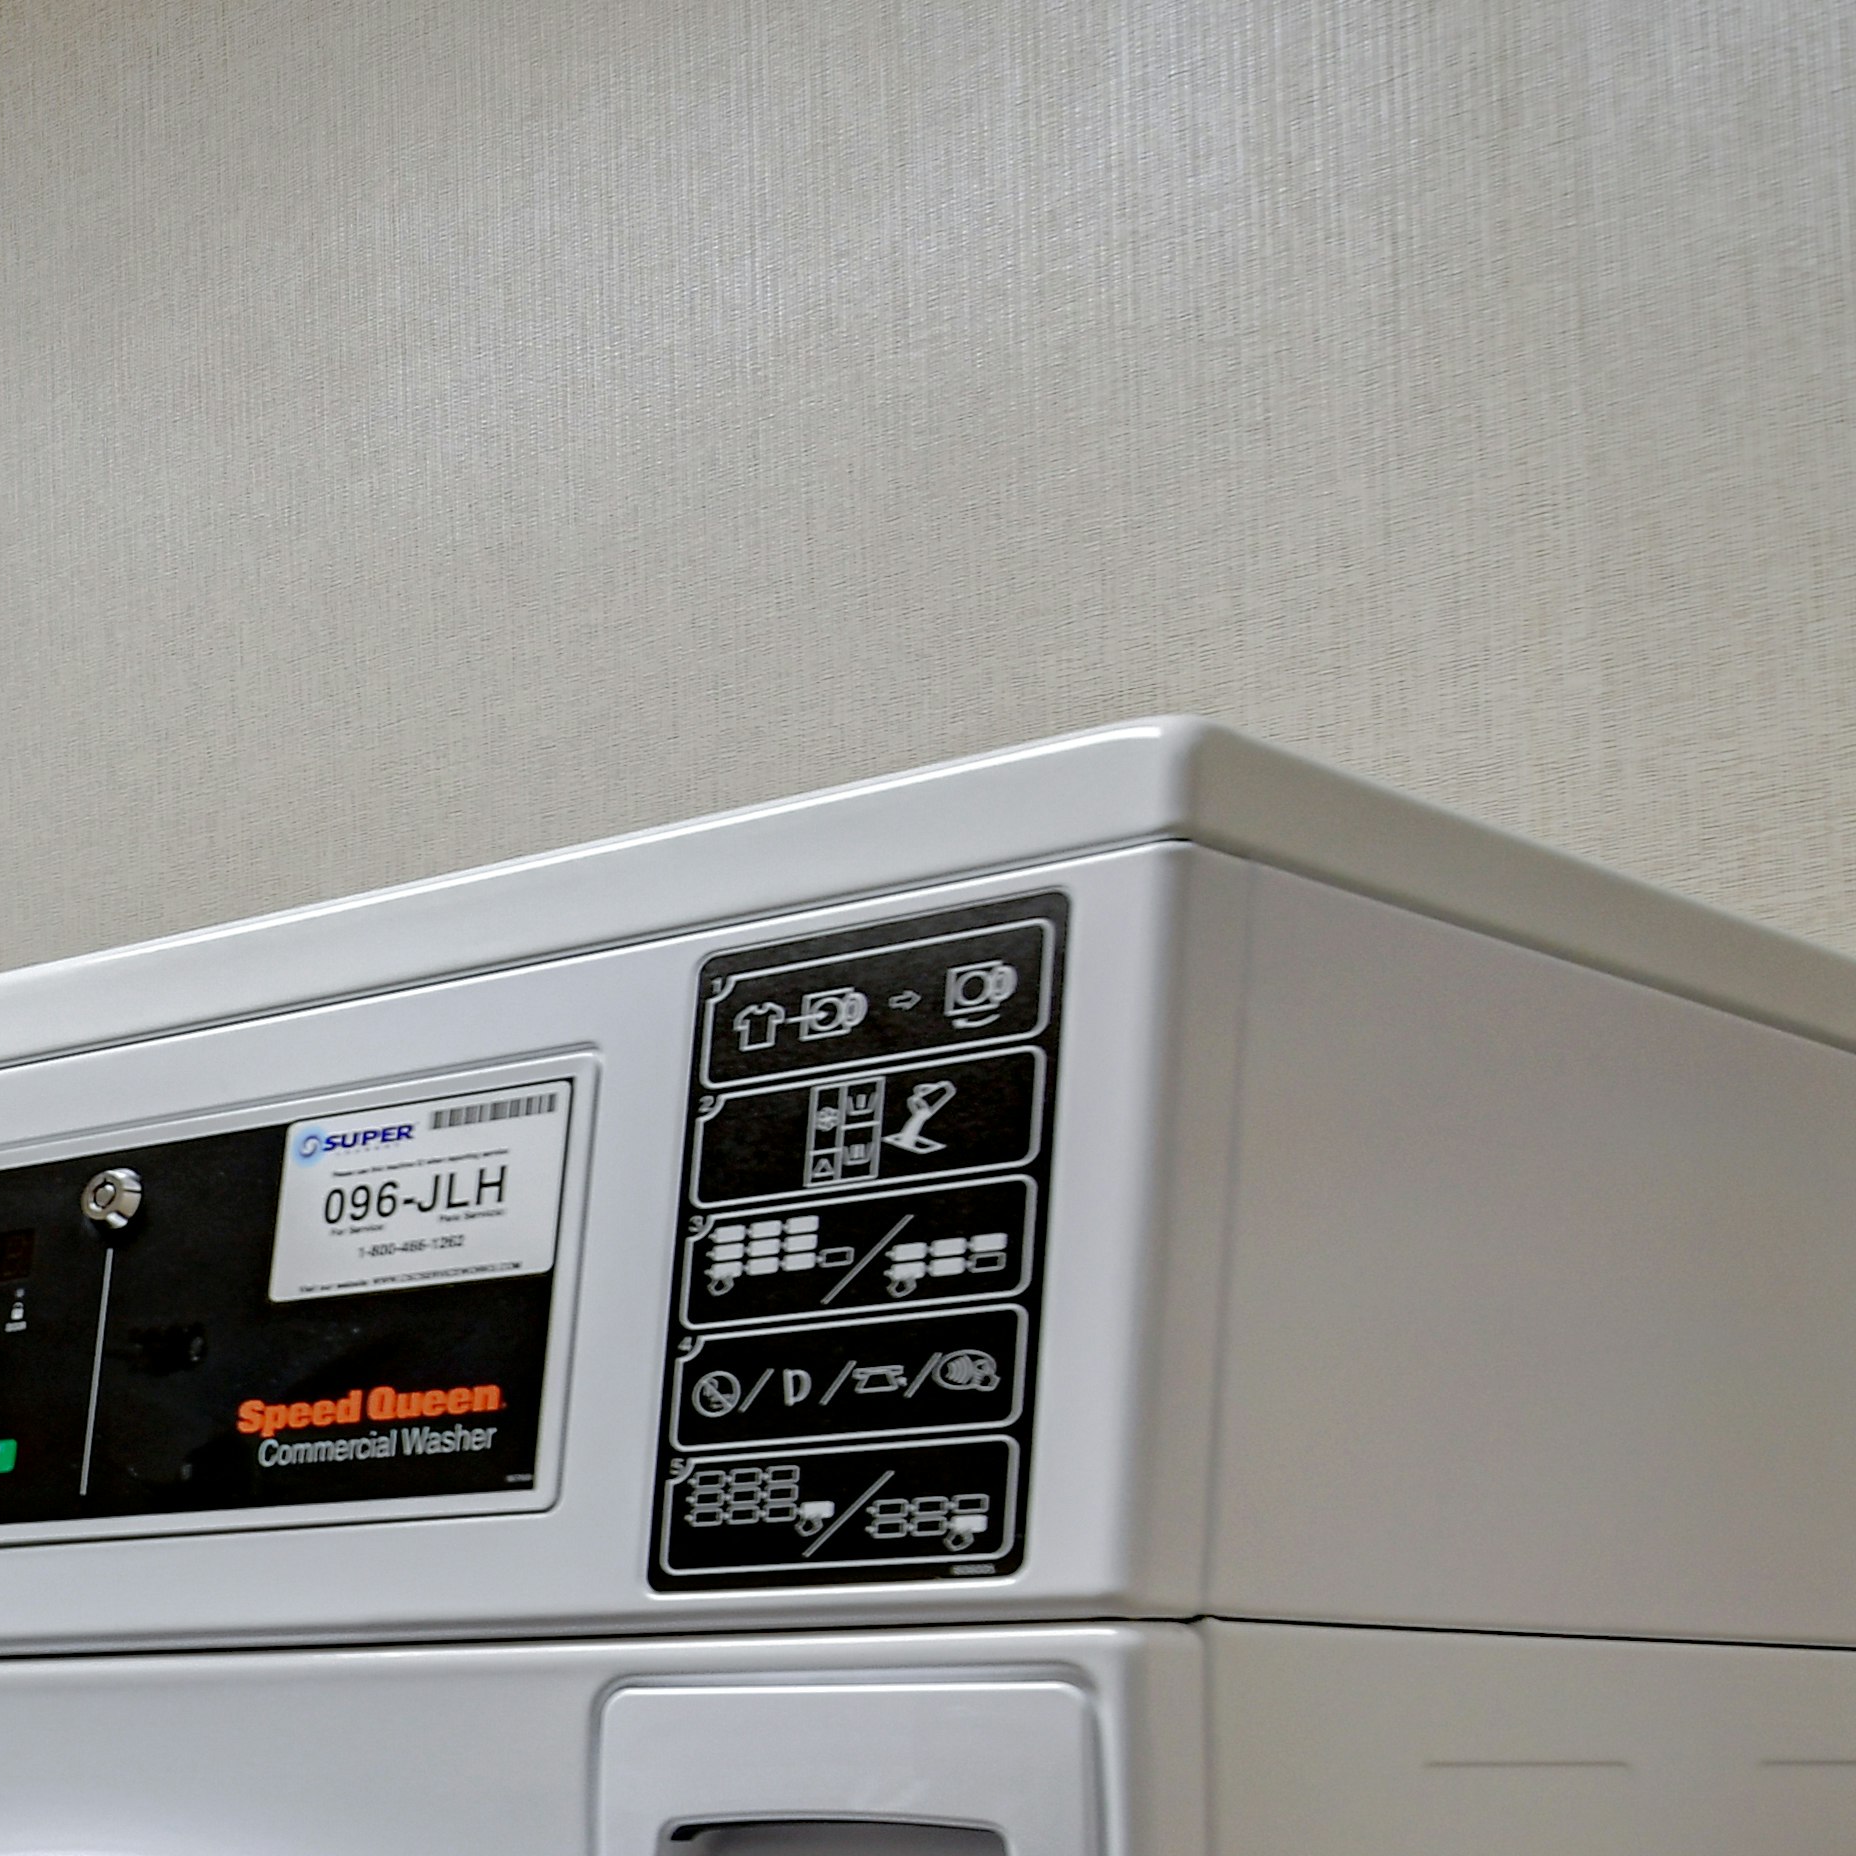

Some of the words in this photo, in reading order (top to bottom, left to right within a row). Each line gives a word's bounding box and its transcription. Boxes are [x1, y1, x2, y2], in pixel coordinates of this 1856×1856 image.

[322, 1124, 415, 1151] SUPER
[324, 1165, 508, 1225] 096-JLH
[237, 1390, 363, 1437] Speed
[367, 1384, 501, 1421] Queen
[258, 1430, 396, 1468] Commercial
[402, 1424, 498, 1455] Washer
